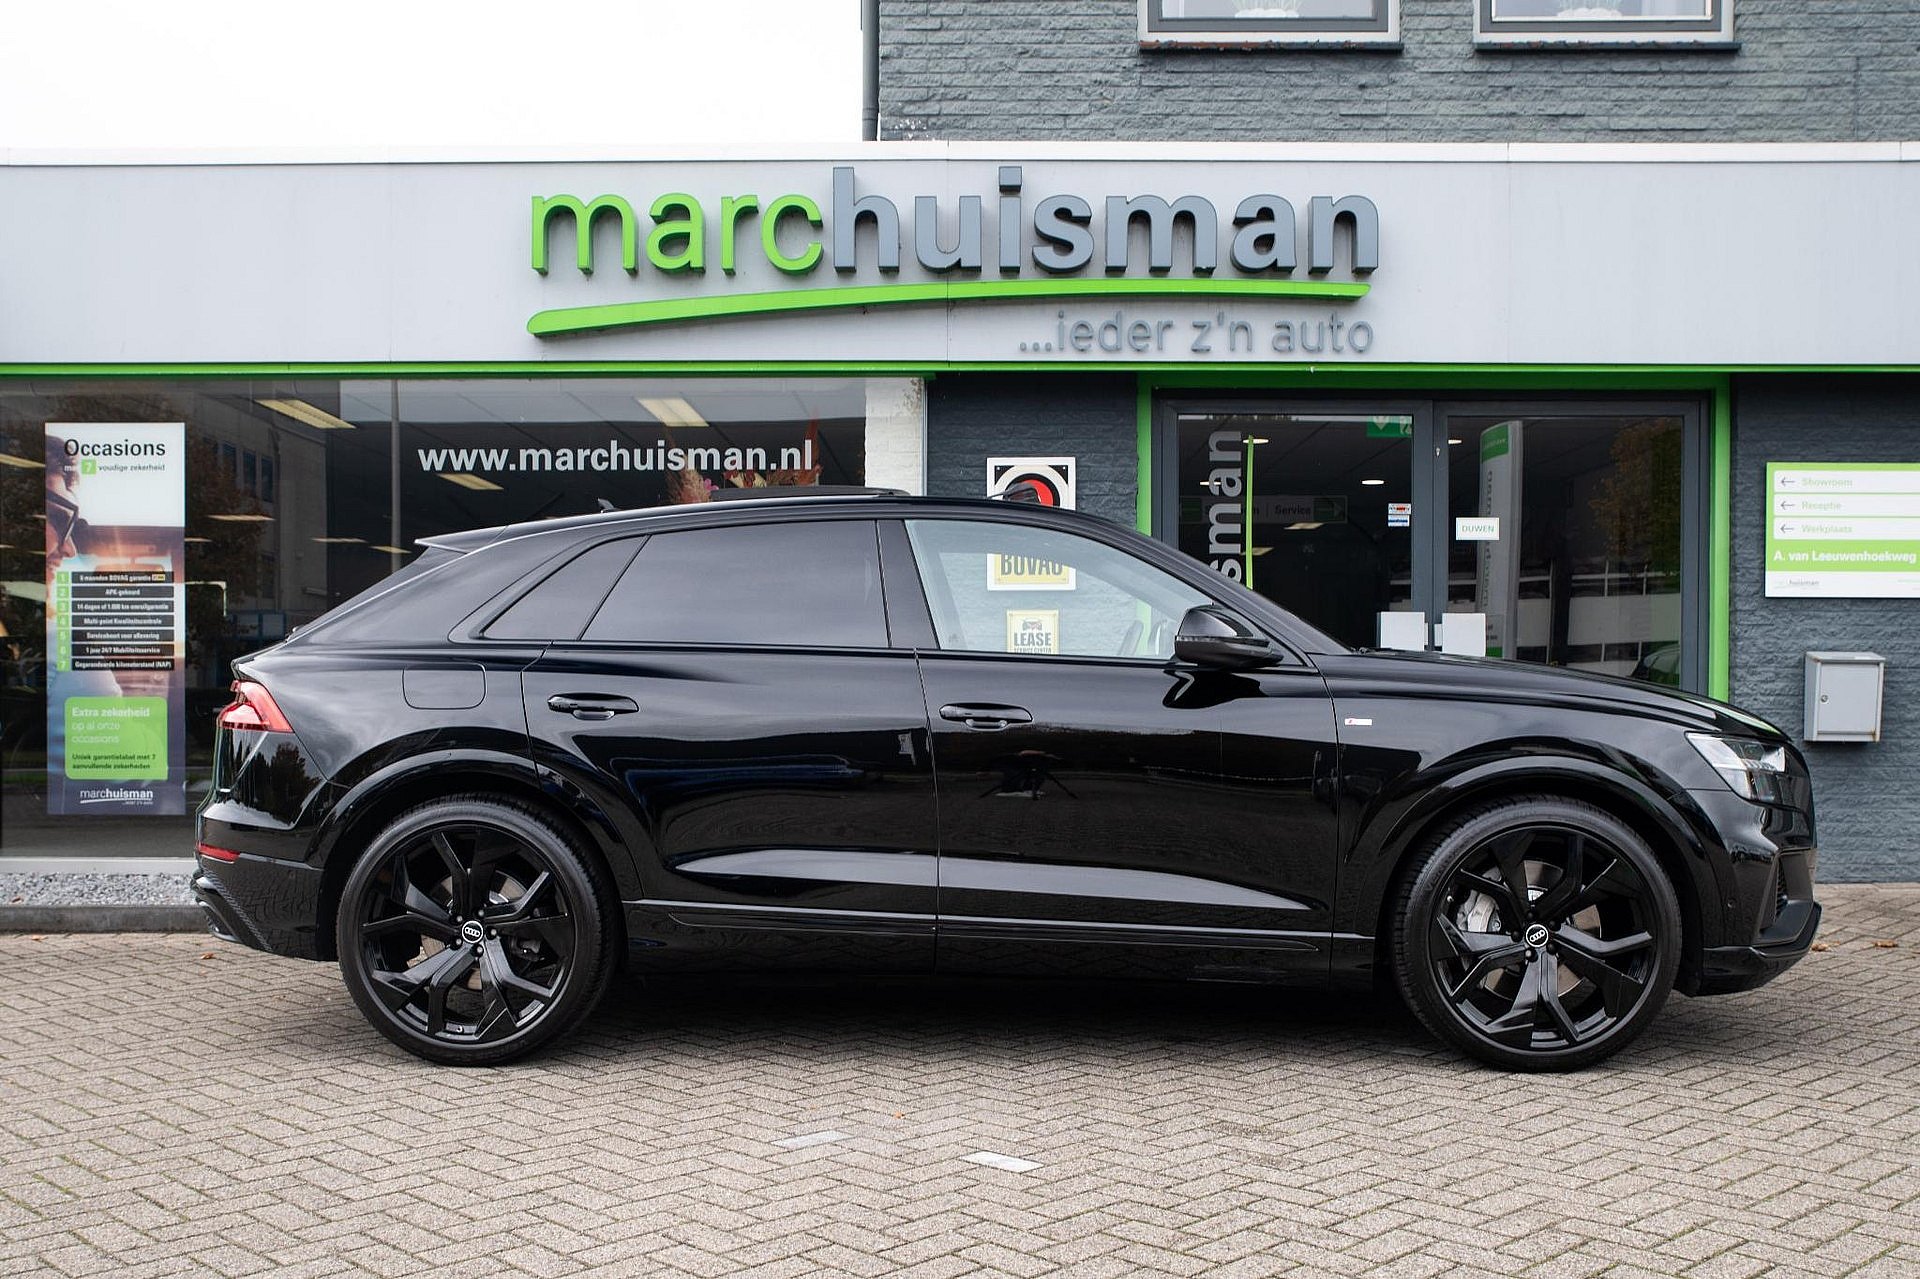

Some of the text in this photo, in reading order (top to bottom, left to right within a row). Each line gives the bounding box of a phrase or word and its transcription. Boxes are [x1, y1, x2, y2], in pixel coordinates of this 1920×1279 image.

[530, 166, 1380, 276] marchuisman
[1191, 311, 1252, 352] z'n
[1271, 311, 1374, 352] auto
[64, 438, 166, 456] Occasions
[418, 440, 812, 472] www.marchuisman.nl
[98, 464, 128, 473] voudige
[1802, 478, 1853, 487] Showroom
[1274, 504, 1311, 515] Service
[1802, 501, 1842, 510] Receptie
[1801, 525, 1853, 534] Werkplaats
[1774, 551, 1917, 564] A. van Leeuwenhoekweg
[1014, 632, 1052, 647] LEASE
[72, 706, 150, 717] Extra zekerheid
[72, 720, 120, 732] op al onze
[72, 735, 120, 744] occasions
[80, 788, 154, 798] marchuisman
